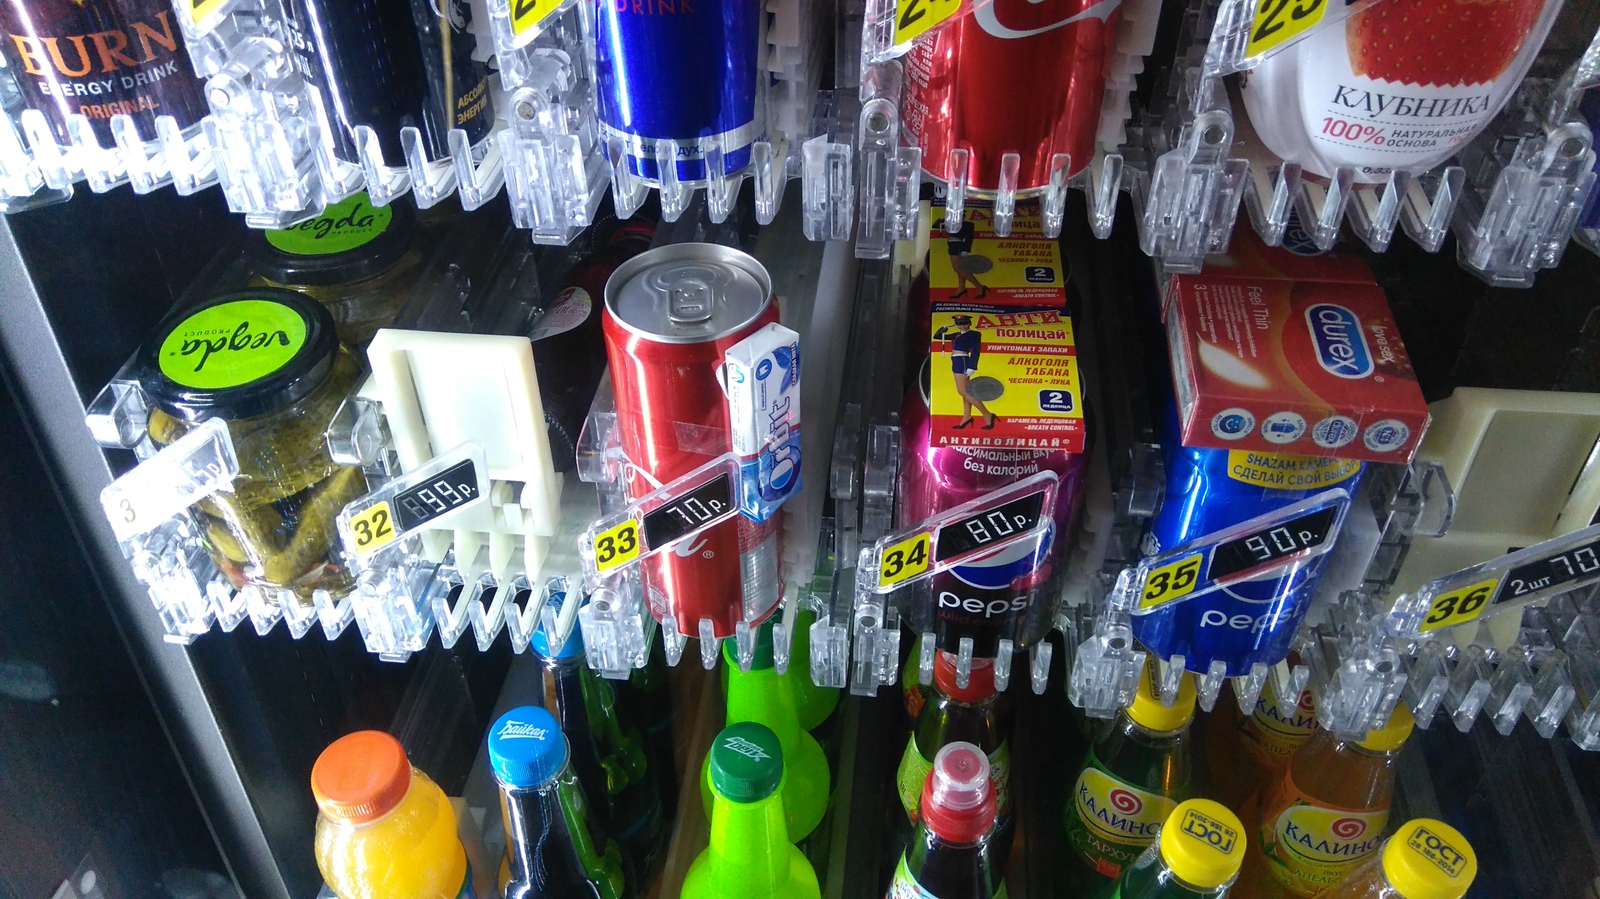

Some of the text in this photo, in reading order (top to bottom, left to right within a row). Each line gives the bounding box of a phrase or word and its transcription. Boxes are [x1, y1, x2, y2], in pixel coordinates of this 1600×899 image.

[8, 10, 178, 77] BURN
[38, 60, 178, 97] EERGY DRINK
[79, 95, 160, 120] ORIGINAL
[1330, 84, 1490, 119] КЛУБНИКА
[1322, 117, 1385, 146] 100%
[1386, 138, 1437, 148] ОСНОВА
[677, 144, 703, 157] дух.
[331, 228, 373, 236] PRODUCT
[998, 242, 1052, 250] АЛКОГОЛЯ
[1034, 268, 1047, 277] 2
[975, 310, 1065, 329] АНТИ
[1246, 286, 1271, 330] Feel Thin
[183, 328, 230, 337] PRODUCT
[1318, 308, 1360, 373] durex
[1373, 325, 1395, 363] love sex
[180, 321, 290, 373] vegda
[986, 345, 1068, 354] УНИЧТОЖАЕТ ЗАПАХИ
[1007, 357, 1070, 367] АЛКОГОЛЯ
[1025, 367, 1070, 377] ТАБАКА
[1049, 392, 1063, 404] 2
[939, 436, 1060, 447] АНТИПОЛИЦАЙ
[963, 457, 1039, 479] без калорий
[1233, 463, 1285, 484] СДЕЛАЙ
[1287, 473, 1322, 486] СВОЙ
[1246, 453, 1341, 471] SHAZAM КАМЕР
[353, 509, 392, 547] 32
[597, 526, 637, 564] 33
[883, 538, 927, 578] 34
[1549, 548, 1600, 576] 70
[1145, 560, 1198, 600] 35
[938, 592, 1034, 618] pepsi
[1426, 586, 1491, 624] 36
[1200, 605, 1300, 634] pepsi
[497, 719, 546, 741] Байкал
[1079, 781, 1162, 835] КАЛИНО
[1183, 820, 1232, 852] ГОСТ
[1285, 819, 1381, 856] КАЛИНО
[1415, 828, 1465, 866] ГОСТ
[1294, 869, 1343, 884] АПЕЛЬС
